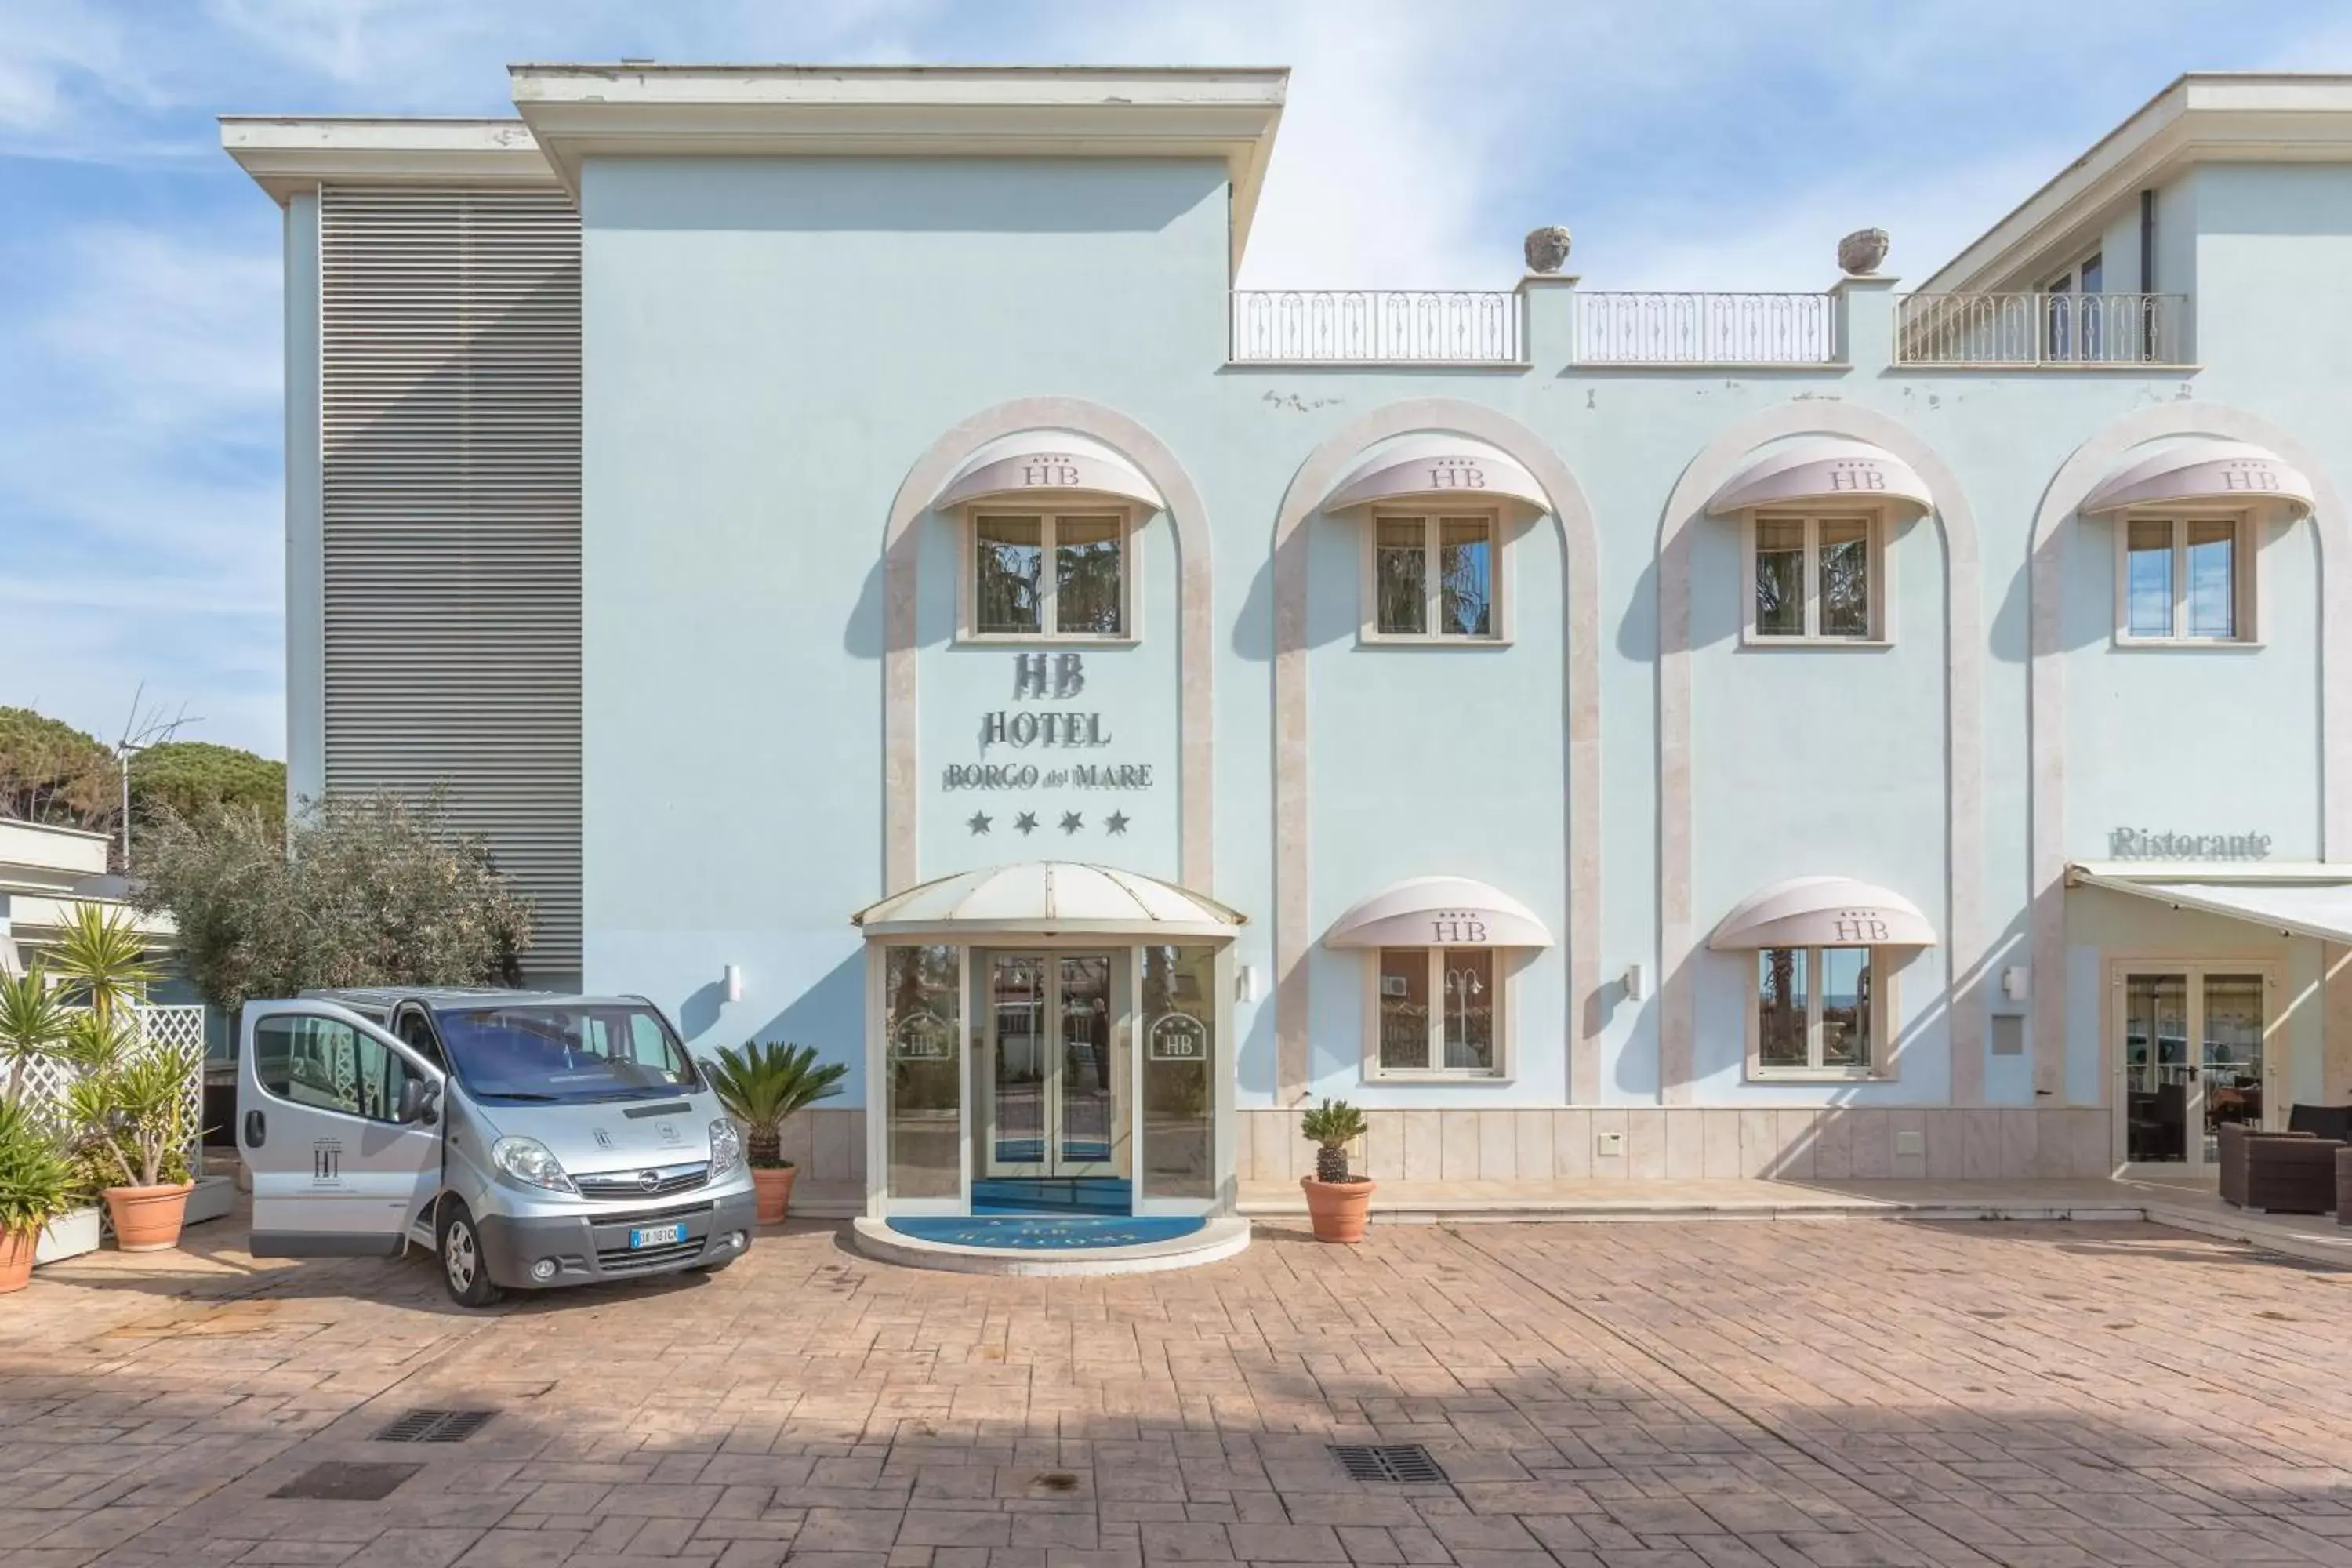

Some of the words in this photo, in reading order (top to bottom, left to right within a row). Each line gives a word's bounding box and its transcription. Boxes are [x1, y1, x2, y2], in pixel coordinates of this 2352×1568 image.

[1022, 465, 1079, 485] HB
[1428, 468, 1485, 488] HB
[1828, 470, 1885, 490] HB
[2220, 471, 2279, 490] HB
[1014, 653, 1084, 697] HB
[984, 710, 1112, 746] HOTEL
[946, 764, 1039, 788] BORGO
[1075, 764, 1152, 788] MARE
[2111, 826, 2272, 859] Ristorante
[1430, 921, 1486, 942] HB
[1833, 919, 1889, 941] HB
[1166, 1034, 1192, 1054] HB
